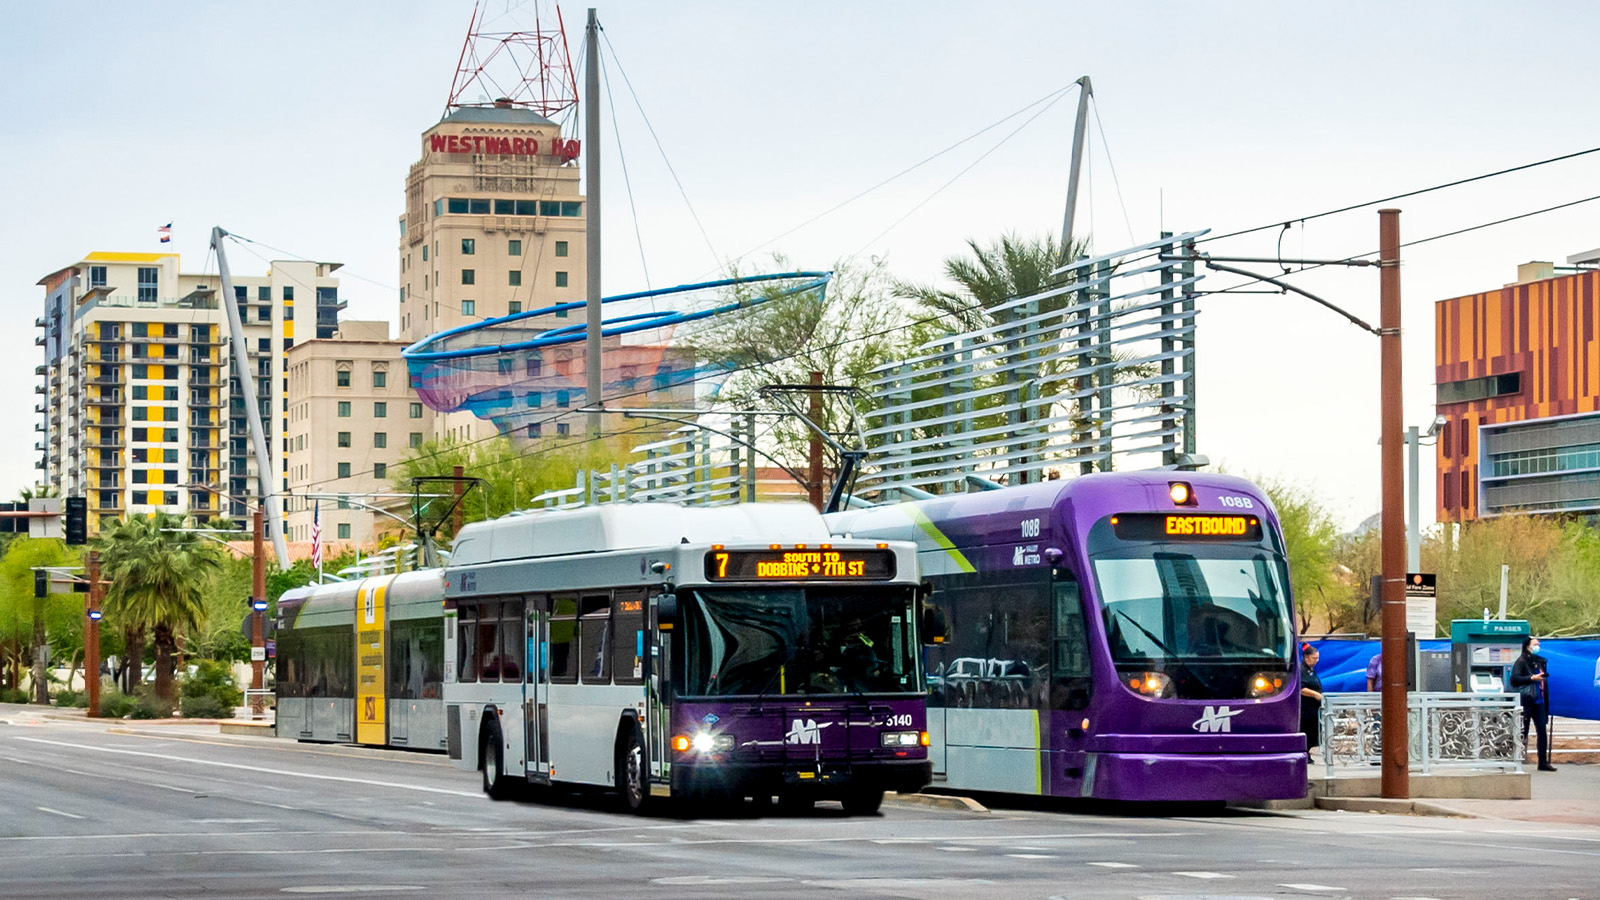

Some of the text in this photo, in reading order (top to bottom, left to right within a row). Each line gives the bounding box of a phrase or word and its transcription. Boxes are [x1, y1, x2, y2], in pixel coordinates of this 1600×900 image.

[430, 134, 538, 156] WESTWARD
[1218, 495, 1254, 509] 108B
[1021, 518, 1040, 538] 108B
[1166, 516, 1246, 535] EASTBOUND
[716, 553, 729, 578] 7
[783, 552, 840, 563] SOUTH TO
[757, 562, 809, 577] DOBBINS
[822, 562, 846, 577] 7TH
[849, 561, 865, 576] ST
